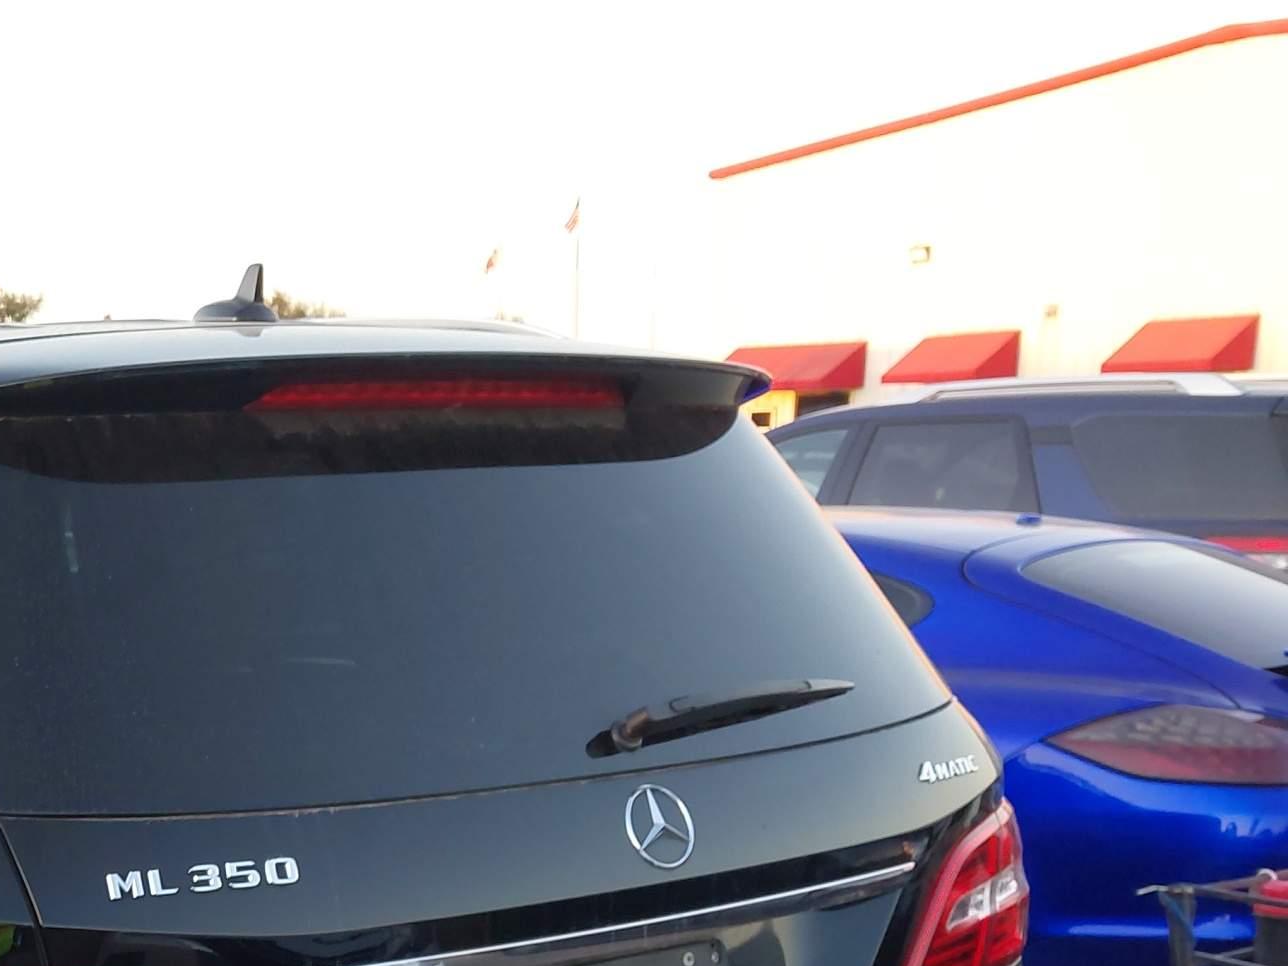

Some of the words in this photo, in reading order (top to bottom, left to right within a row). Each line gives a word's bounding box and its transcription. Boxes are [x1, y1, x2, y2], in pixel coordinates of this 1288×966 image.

[919, 754, 979, 783] 4MATIC
[105, 869, 179, 901] ML
[187, 856, 300, 893] 350
